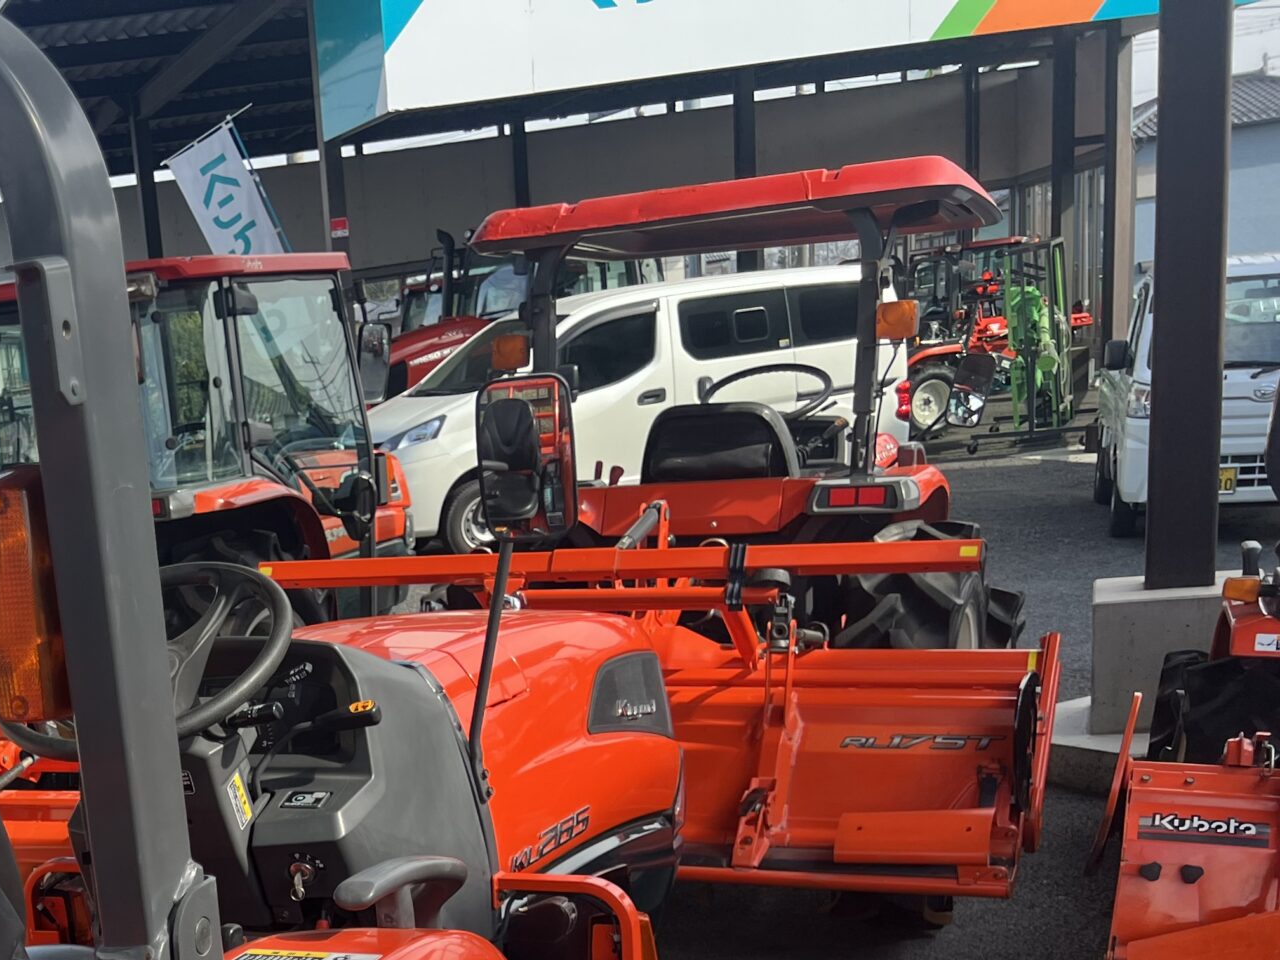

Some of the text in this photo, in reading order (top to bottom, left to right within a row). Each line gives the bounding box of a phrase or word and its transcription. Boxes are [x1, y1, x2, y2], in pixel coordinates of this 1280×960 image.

[840, 734, 1007, 750] RL175T
[1153, 813, 1257, 835] Kubota
[509, 805, 591, 872] KL265
